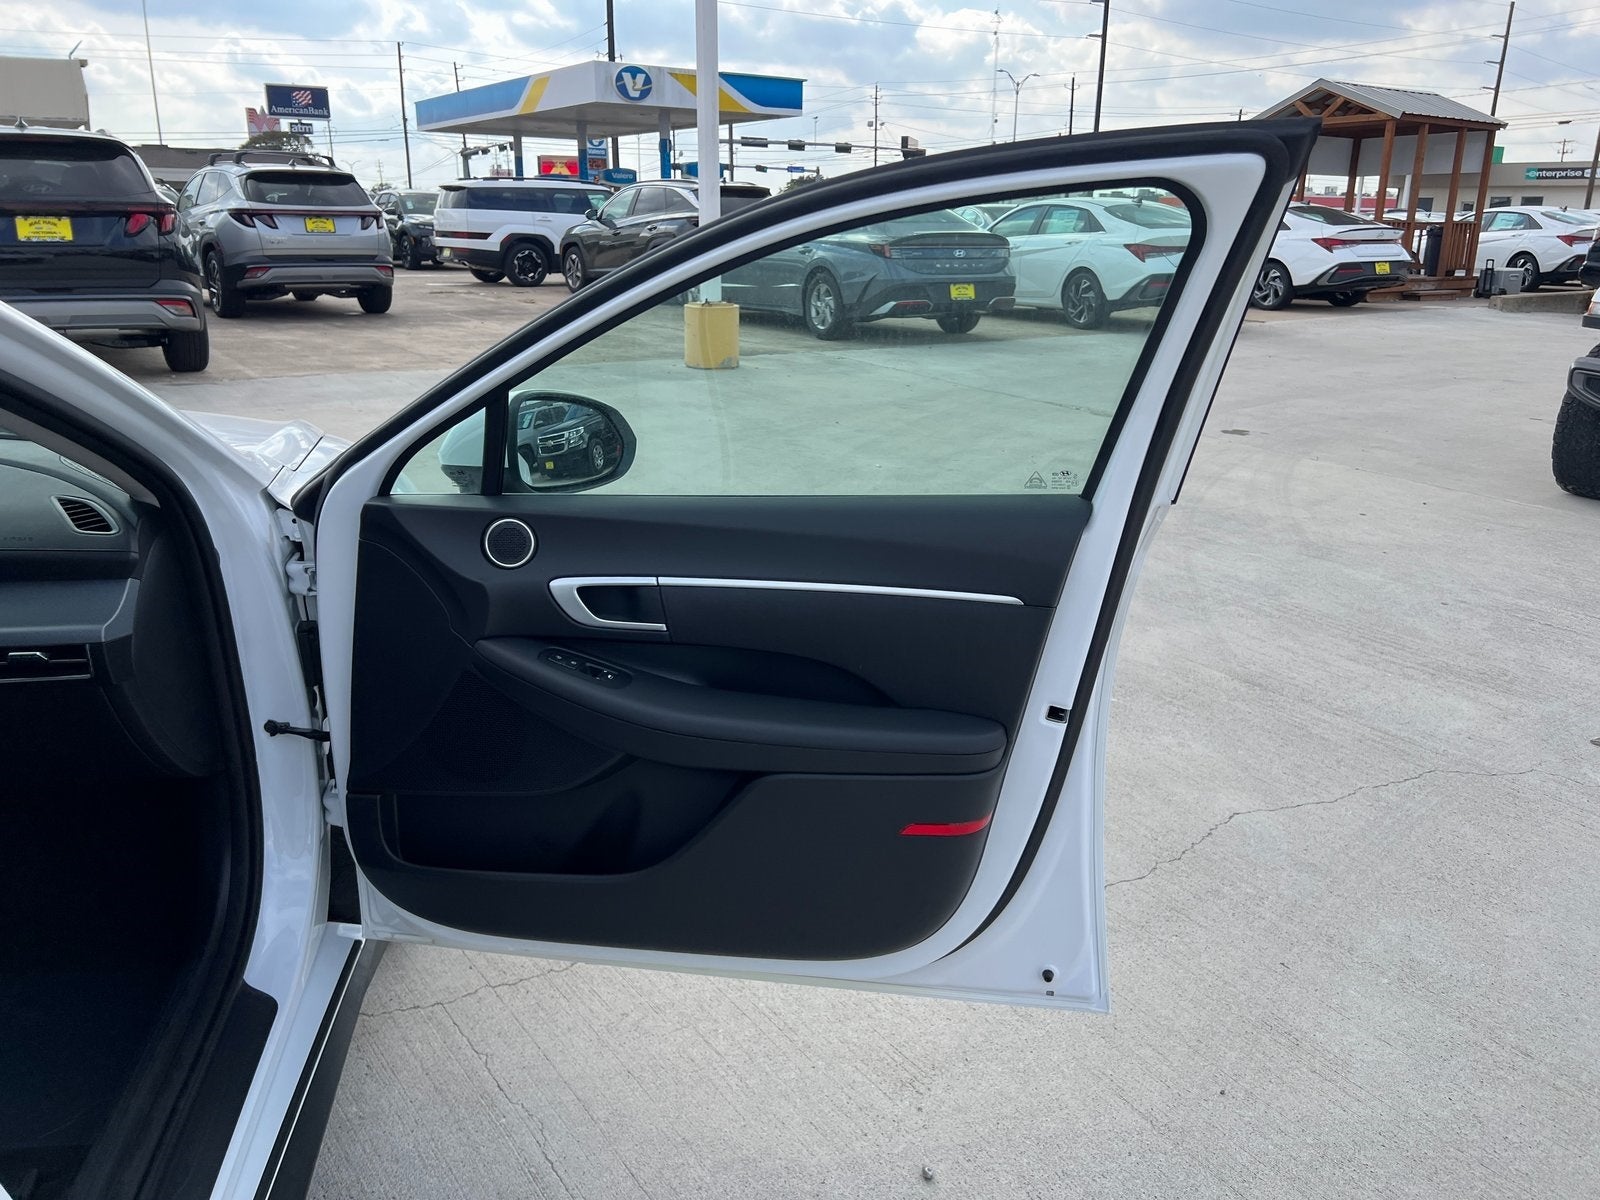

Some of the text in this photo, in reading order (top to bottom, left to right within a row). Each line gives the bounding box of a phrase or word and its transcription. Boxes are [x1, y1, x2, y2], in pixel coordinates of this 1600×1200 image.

[270, 105, 329, 116] AmericanBank
[291, 123, 313, 133] atm
[611, 172, 634, 180] Valero
[1525, 169, 1583, 179] enterprise
